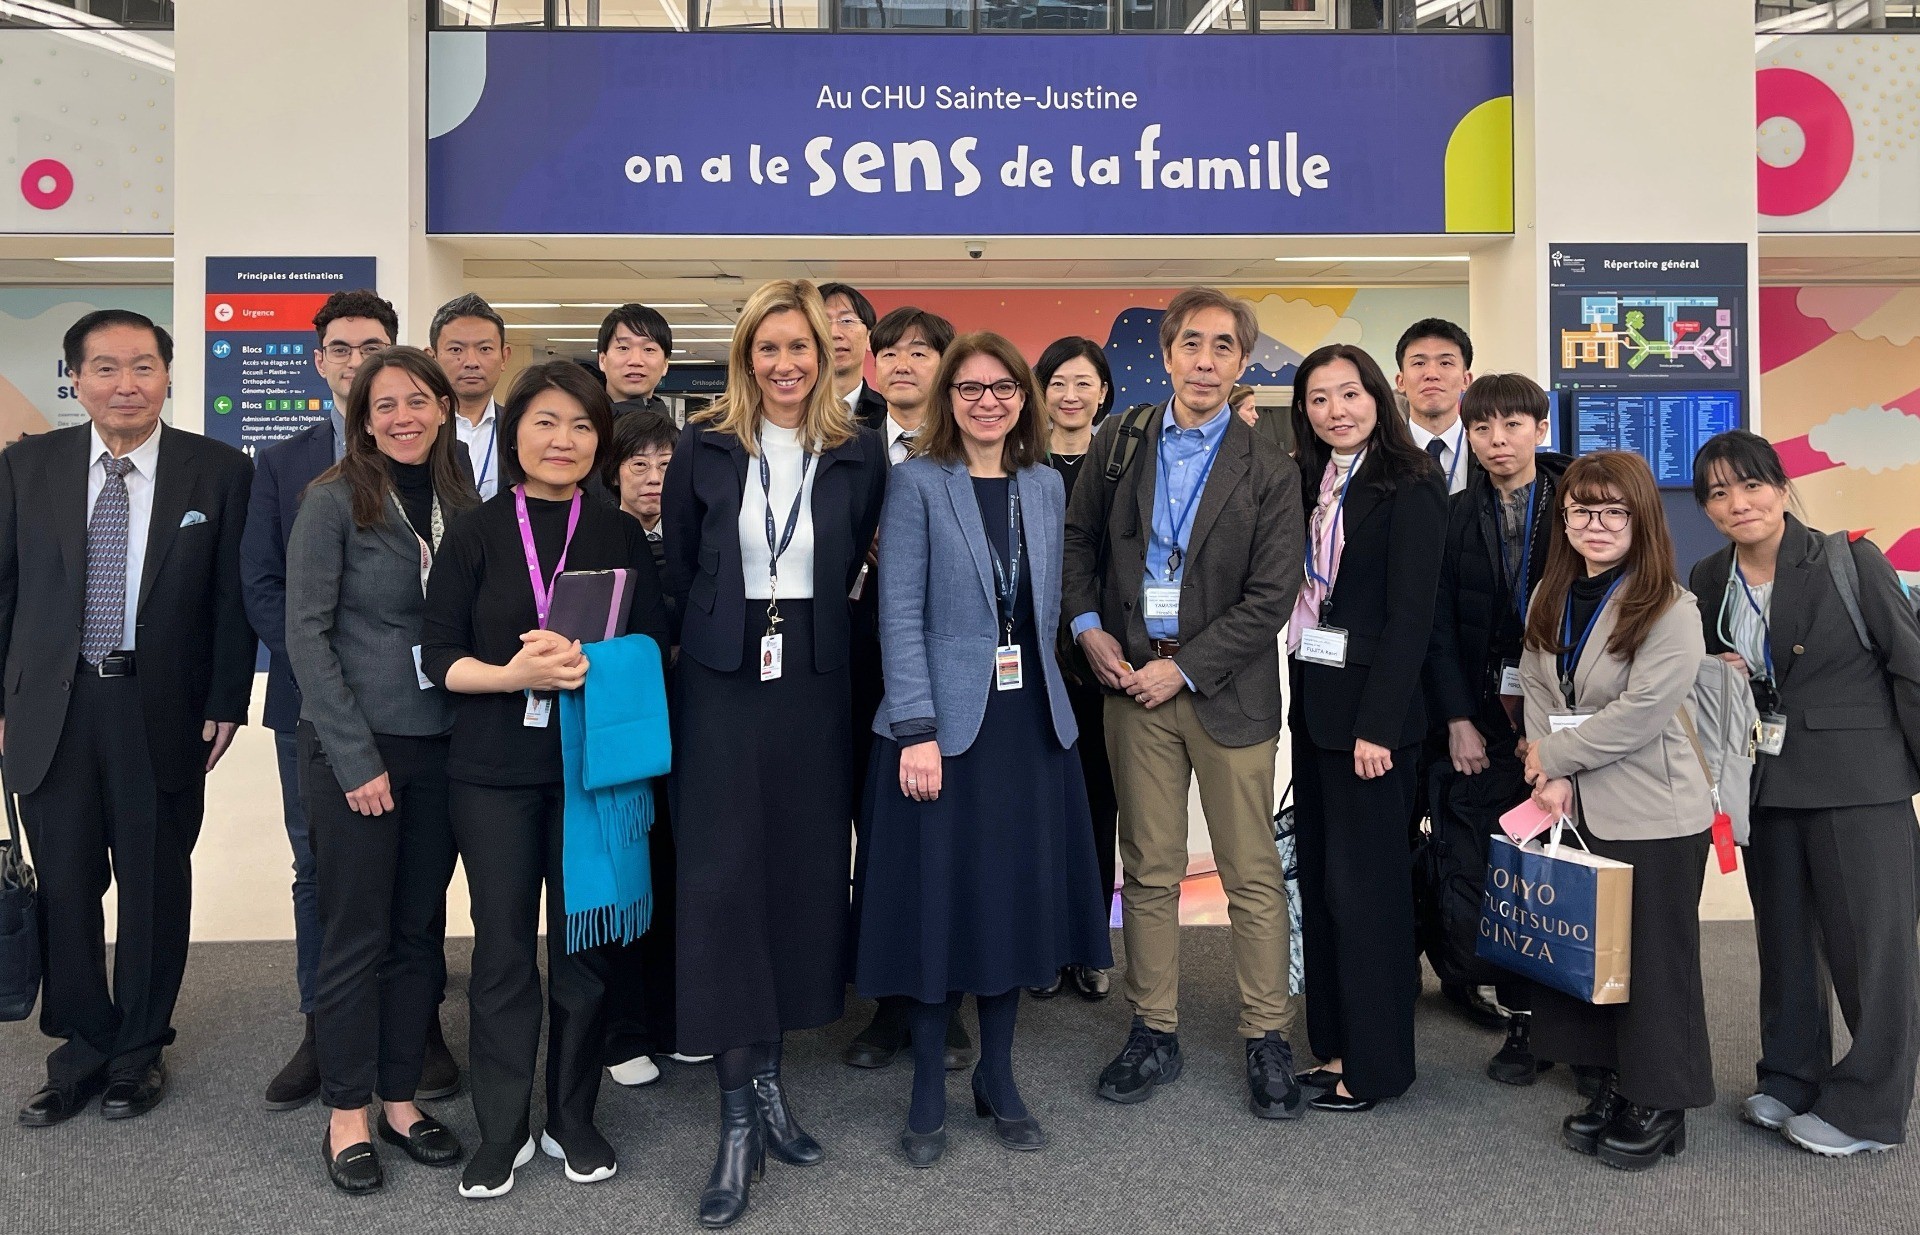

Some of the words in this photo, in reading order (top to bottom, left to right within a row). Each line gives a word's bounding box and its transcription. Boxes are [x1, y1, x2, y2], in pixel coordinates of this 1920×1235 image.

[816, 85, 852, 110] Au
[861, 85, 926, 110] CHU
[935, 85, 1138, 110] Sainte-Justine
[624, 153, 684, 184] on
[700, 154, 732, 183] a
[749, 143, 790, 186] le
[804, 135, 982, 198] sens
[1000, 145, 1054, 188] de
[1071, 145, 1120, 188] la
[1134, 123, 1331, 198] famille
[1603, 259, 1658, 270] Répertoire
[1660, 259, 1700, 271] général
[237, 272, 287, 282] Principales
[288, 272, 344, 280] destinations
[242, 309, 275, 318] Urgence
[242, 345, 263, 354] Blocs
[282, 345, 289, 353] 8
[270, 359, 289, 367] étages
[242, 378, 276, 386] Orthopédie
[265, 387, 287, 395] Québec
[241, 401, 262, 409] Blocs
[241, 434, 266, 442] Imagerie
[1487, 863, 1555, 906] TOKYO
[1480, 916, 1555, 965] GINZA
